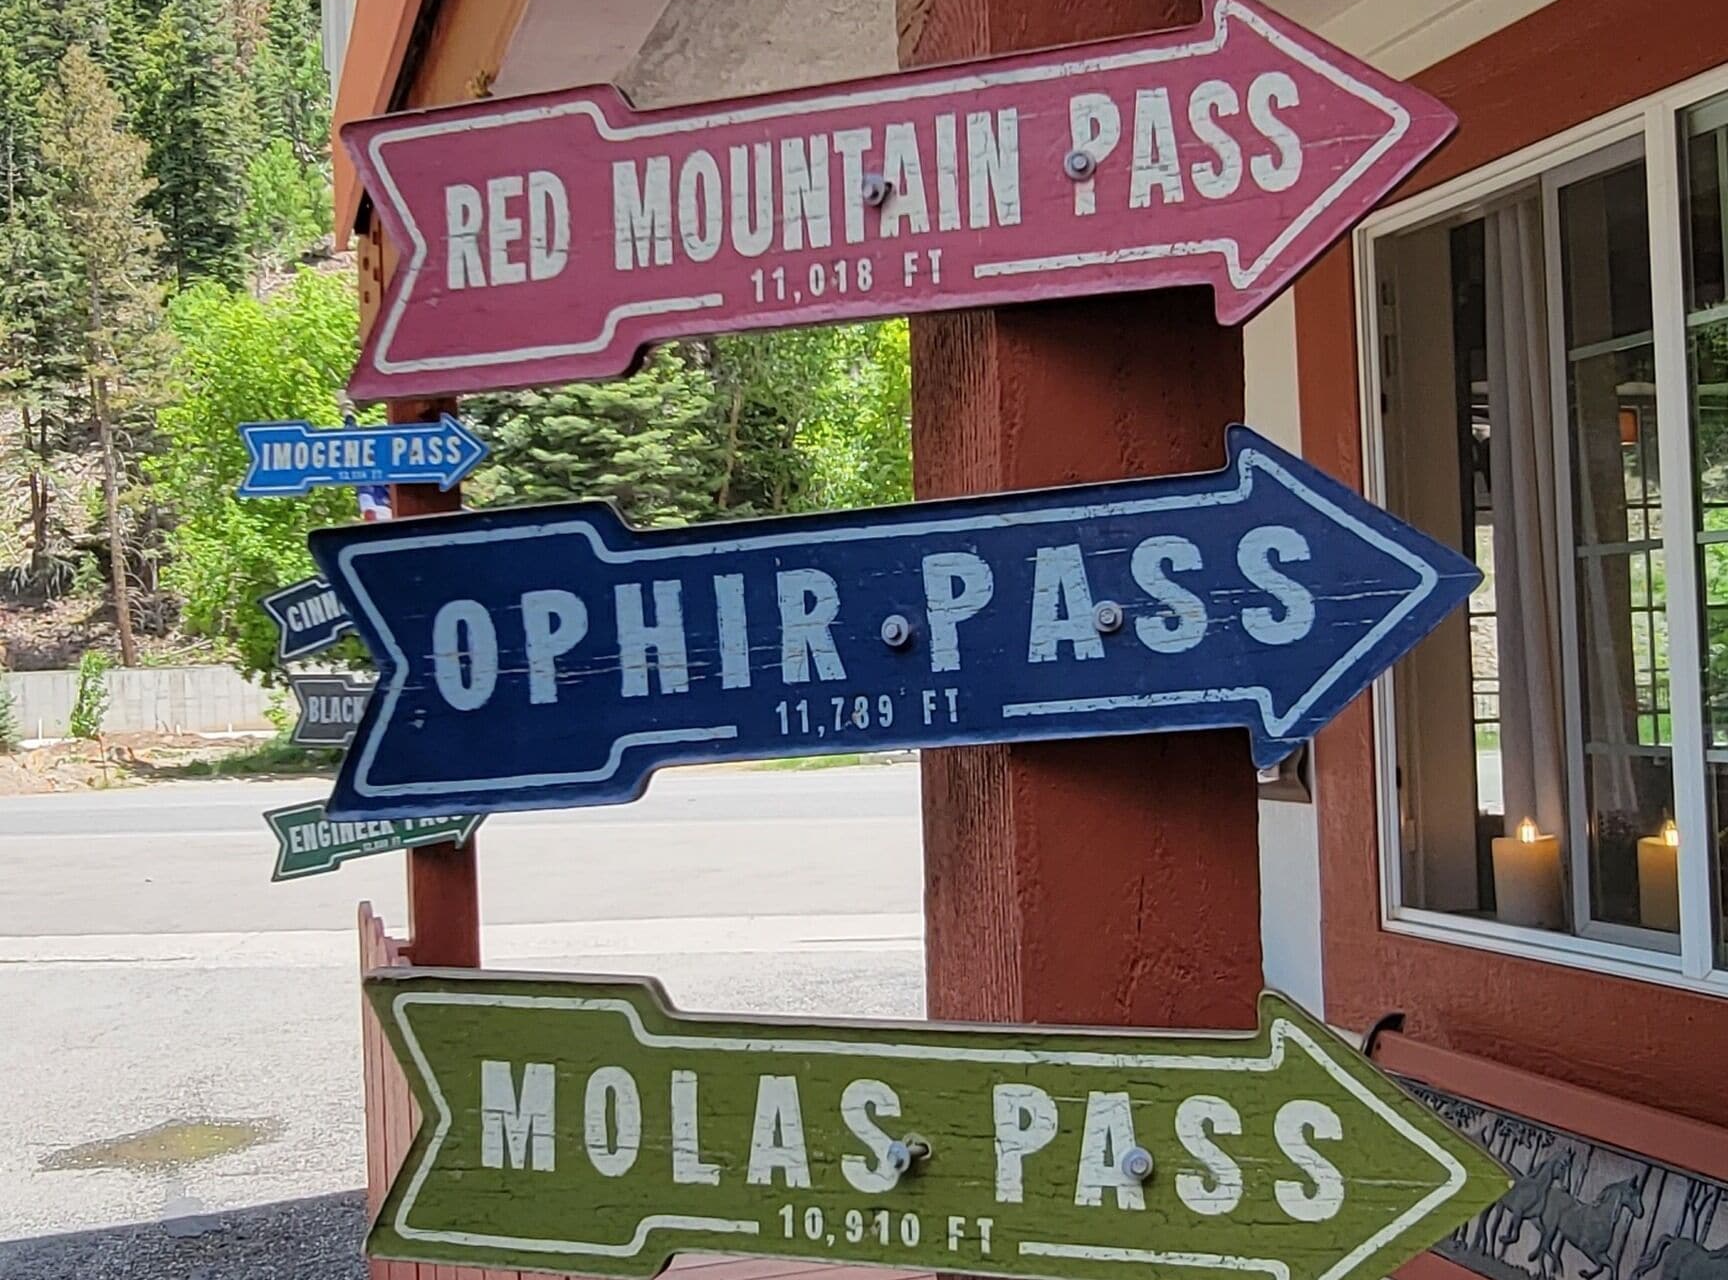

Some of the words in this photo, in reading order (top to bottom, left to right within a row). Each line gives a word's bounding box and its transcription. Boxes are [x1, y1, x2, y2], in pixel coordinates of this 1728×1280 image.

[446, 169, 570, 291] RED
[611, 106, 1022, 272] MOUNTAIN
[1068, 70, 1303, 217] PASS
[751, 257, 873, 304] 11,018
[903, 248, 943, 288] FT
[262, 438, 377, 471] IMOGENE
[391, 435, 463, 467] PASS
[433, 568, 846, 712] OPHIR
[924, 525, 1318, 674] PASS
[308, 695, 366, 724] BLACK
[775, 693, 894, 738] 11,789
[922, 687, 960, 726] FT
[480, 1058, 905, 1195] MOLAS
[991, 1082, 1345, 1224] PASS
[778, 1203, 921, 1248] 10,910
[948, 1215, 994, 1255] FT
